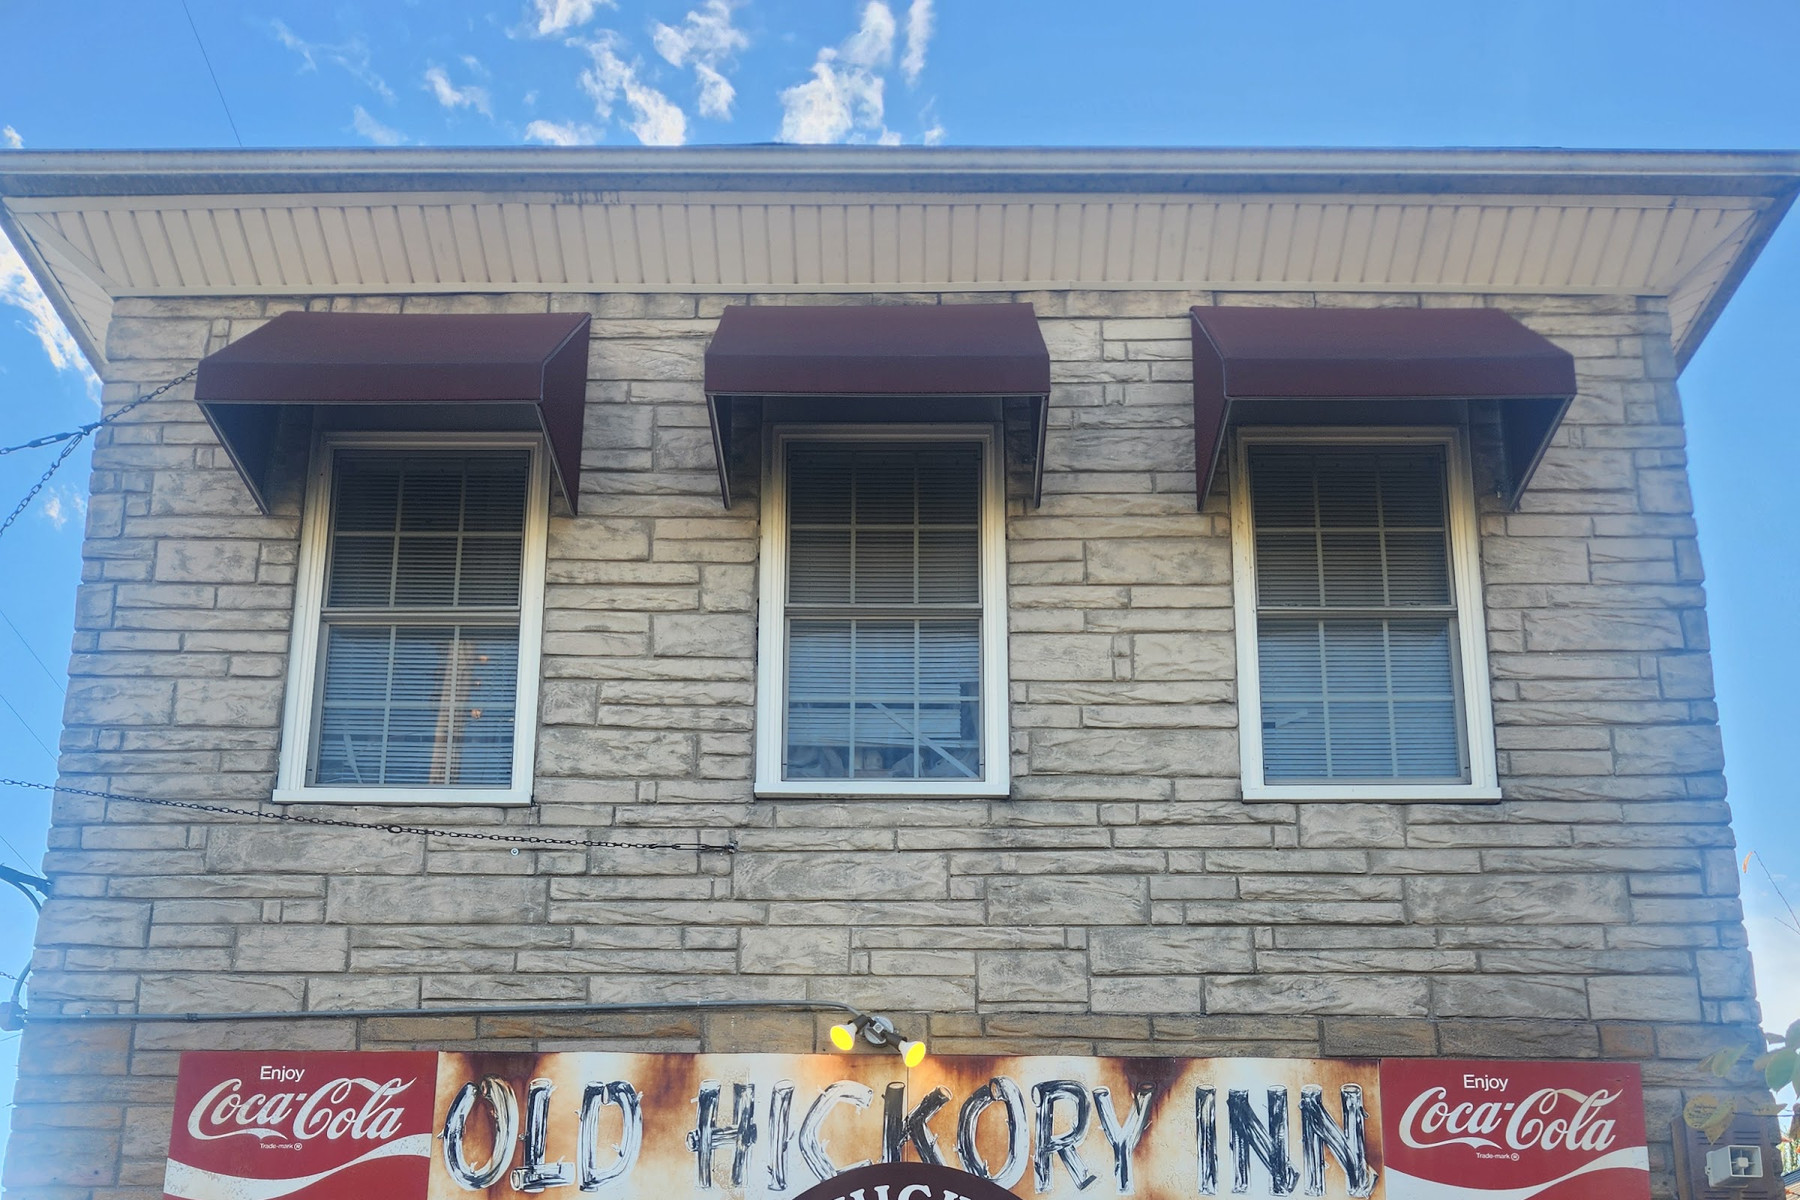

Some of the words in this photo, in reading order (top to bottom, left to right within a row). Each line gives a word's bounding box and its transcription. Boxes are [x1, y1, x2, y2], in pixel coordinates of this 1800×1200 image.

[260, 1065, 305, 1082] Enjoy
[1463, 1074, 1509, 1092] Enjoy
[187, 1077, 417, 1140] Coca-Cola
[437, 1073, 644, 1192] OLD
[685, 1075, 1158, 1192] HICKORY
[1196, 1082, 1379, 1200] INN
[1399, 1086, 1623, 1151] Coca-Cola
